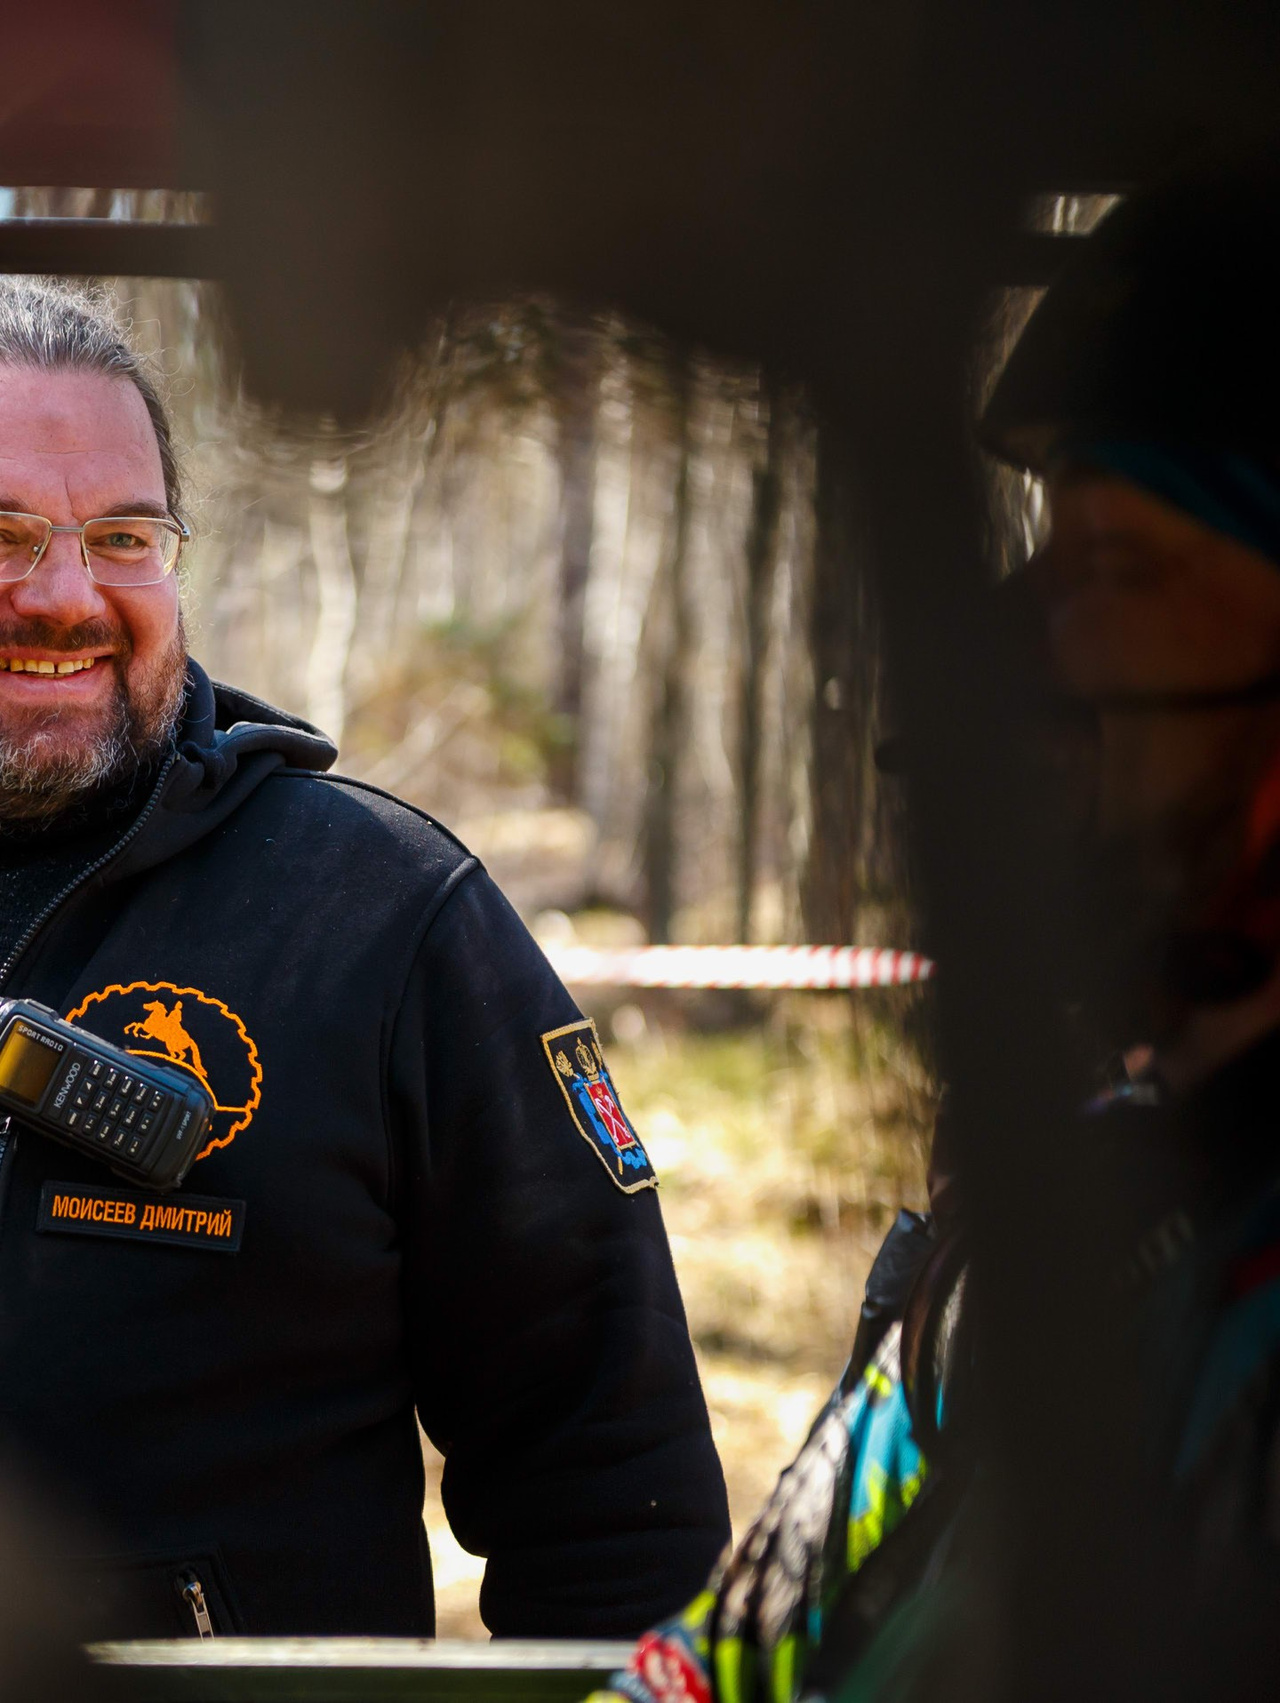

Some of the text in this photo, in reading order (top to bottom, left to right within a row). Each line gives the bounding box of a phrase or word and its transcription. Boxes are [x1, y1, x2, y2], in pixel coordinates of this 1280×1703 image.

[18, 1025, 64, 1051] SPORT RADIO
[54, 1062, 80, 1108] KENWOOD
[52, 1195, 232, 1237] МОИСЕЕВ ДМИТРИЙ
